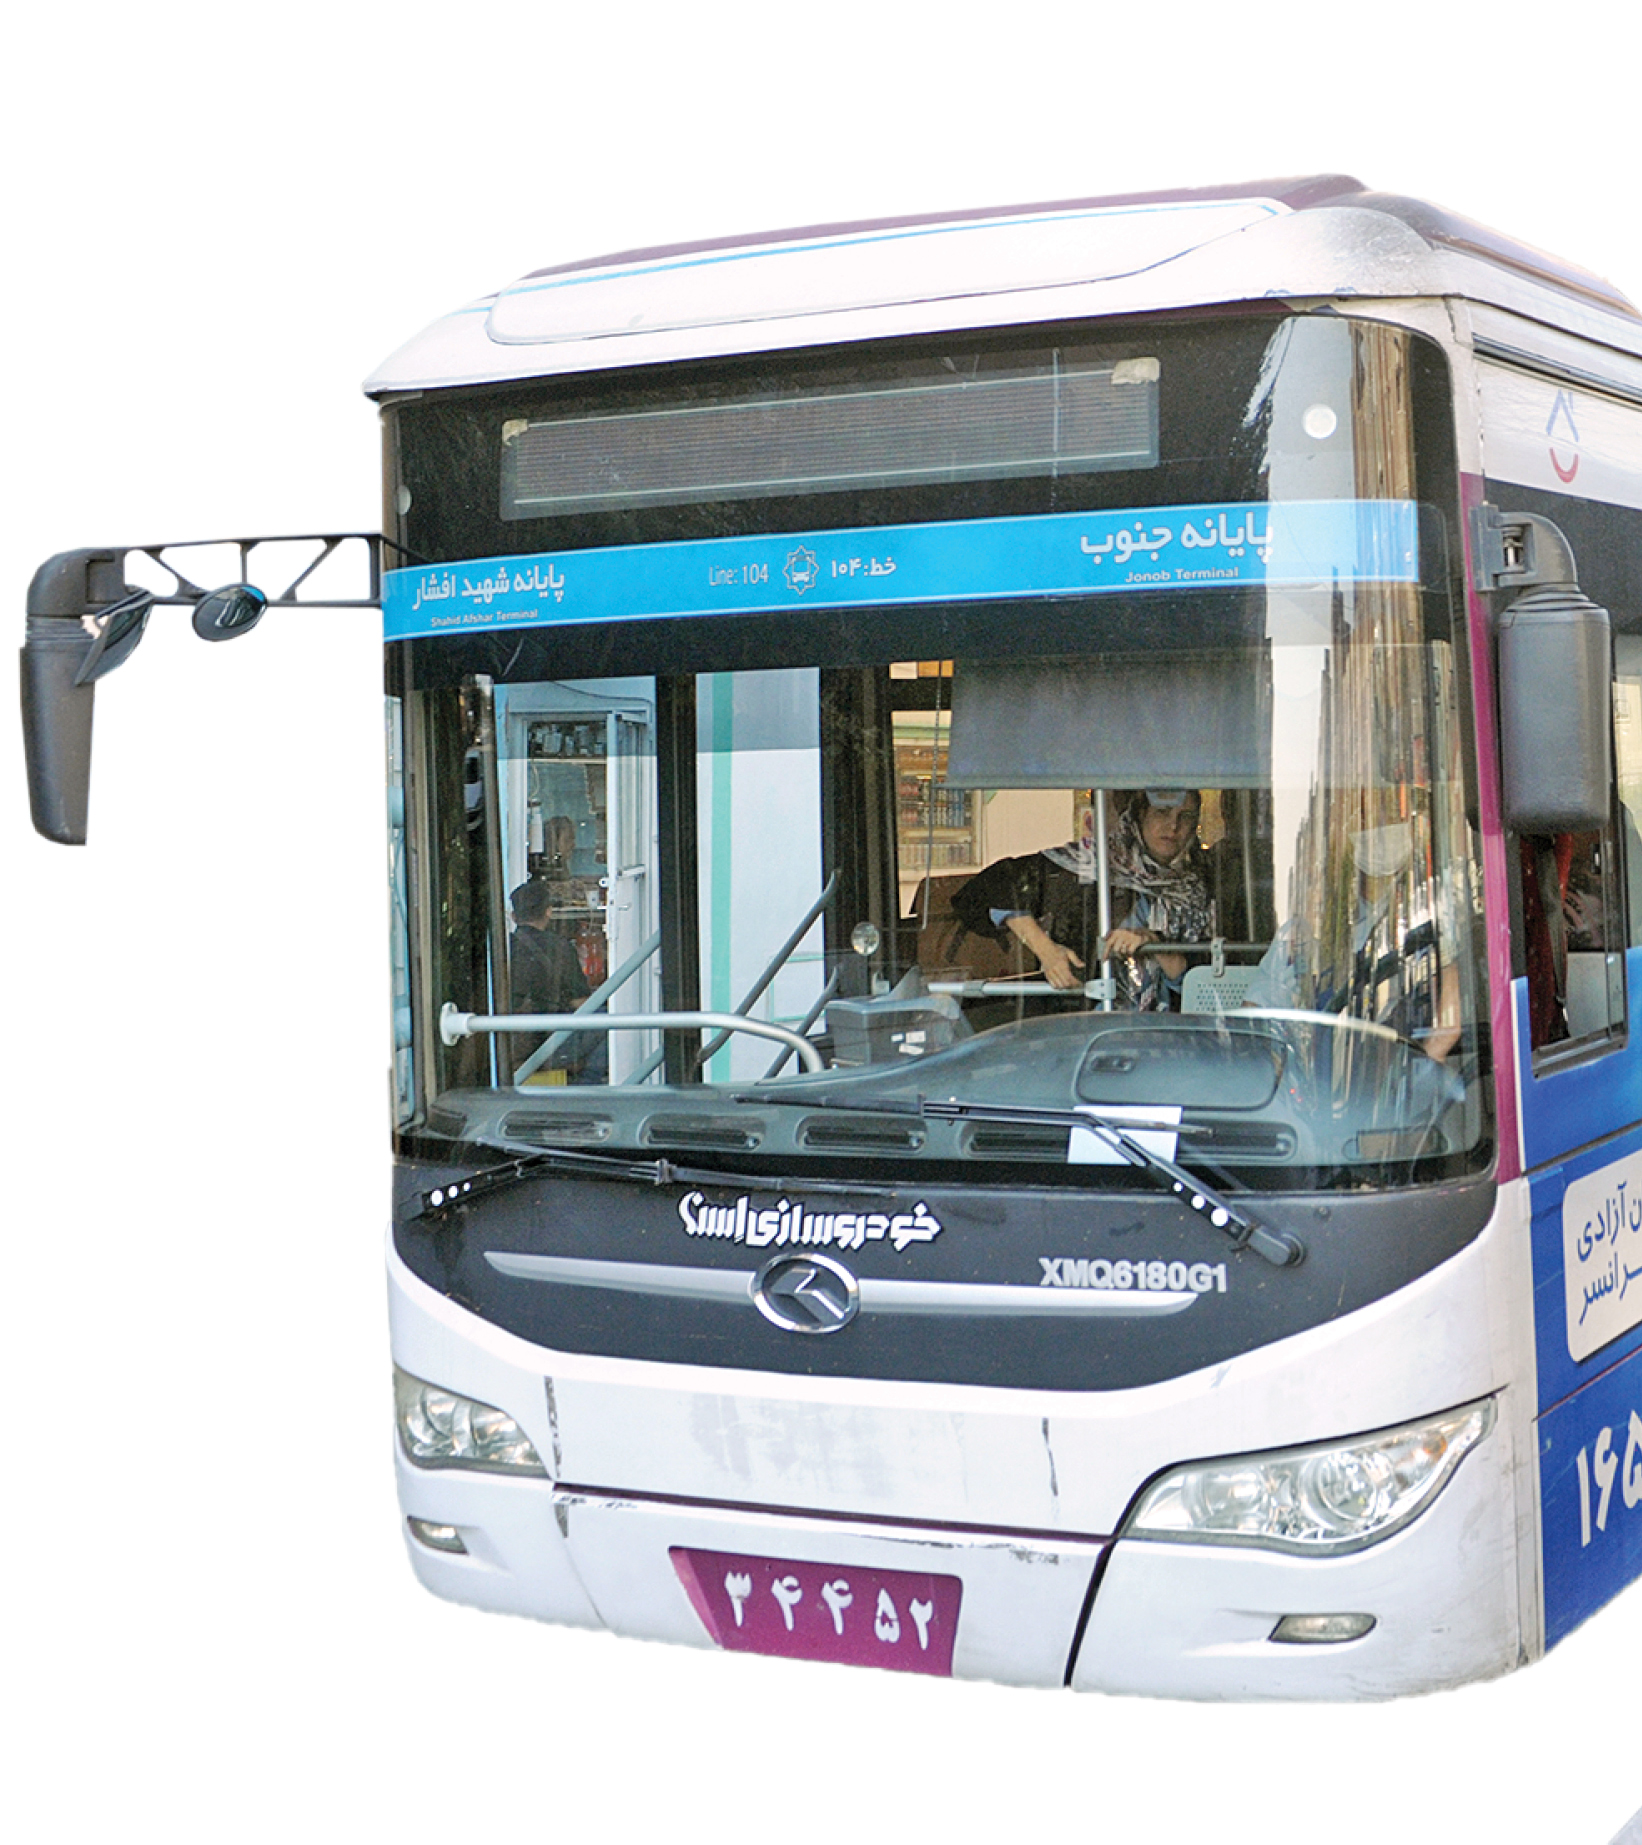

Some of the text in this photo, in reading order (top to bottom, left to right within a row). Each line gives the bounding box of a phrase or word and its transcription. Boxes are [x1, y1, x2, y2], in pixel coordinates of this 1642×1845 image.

[1080, 511, 1274, 565] پایانه جنوب
[411, 563, 565, 611] پایانه شهید افشار
[708, 562, 770, 587] Line: 104
[1125, 566, 1239, 583] Jonob Terminal
[430, 608, 538, 628] Shahid Afshar Terminal
[1576, 1180, 1628, 1262] آزادی
[1038, 1256, 1228, 1294] XMQ6180G1
